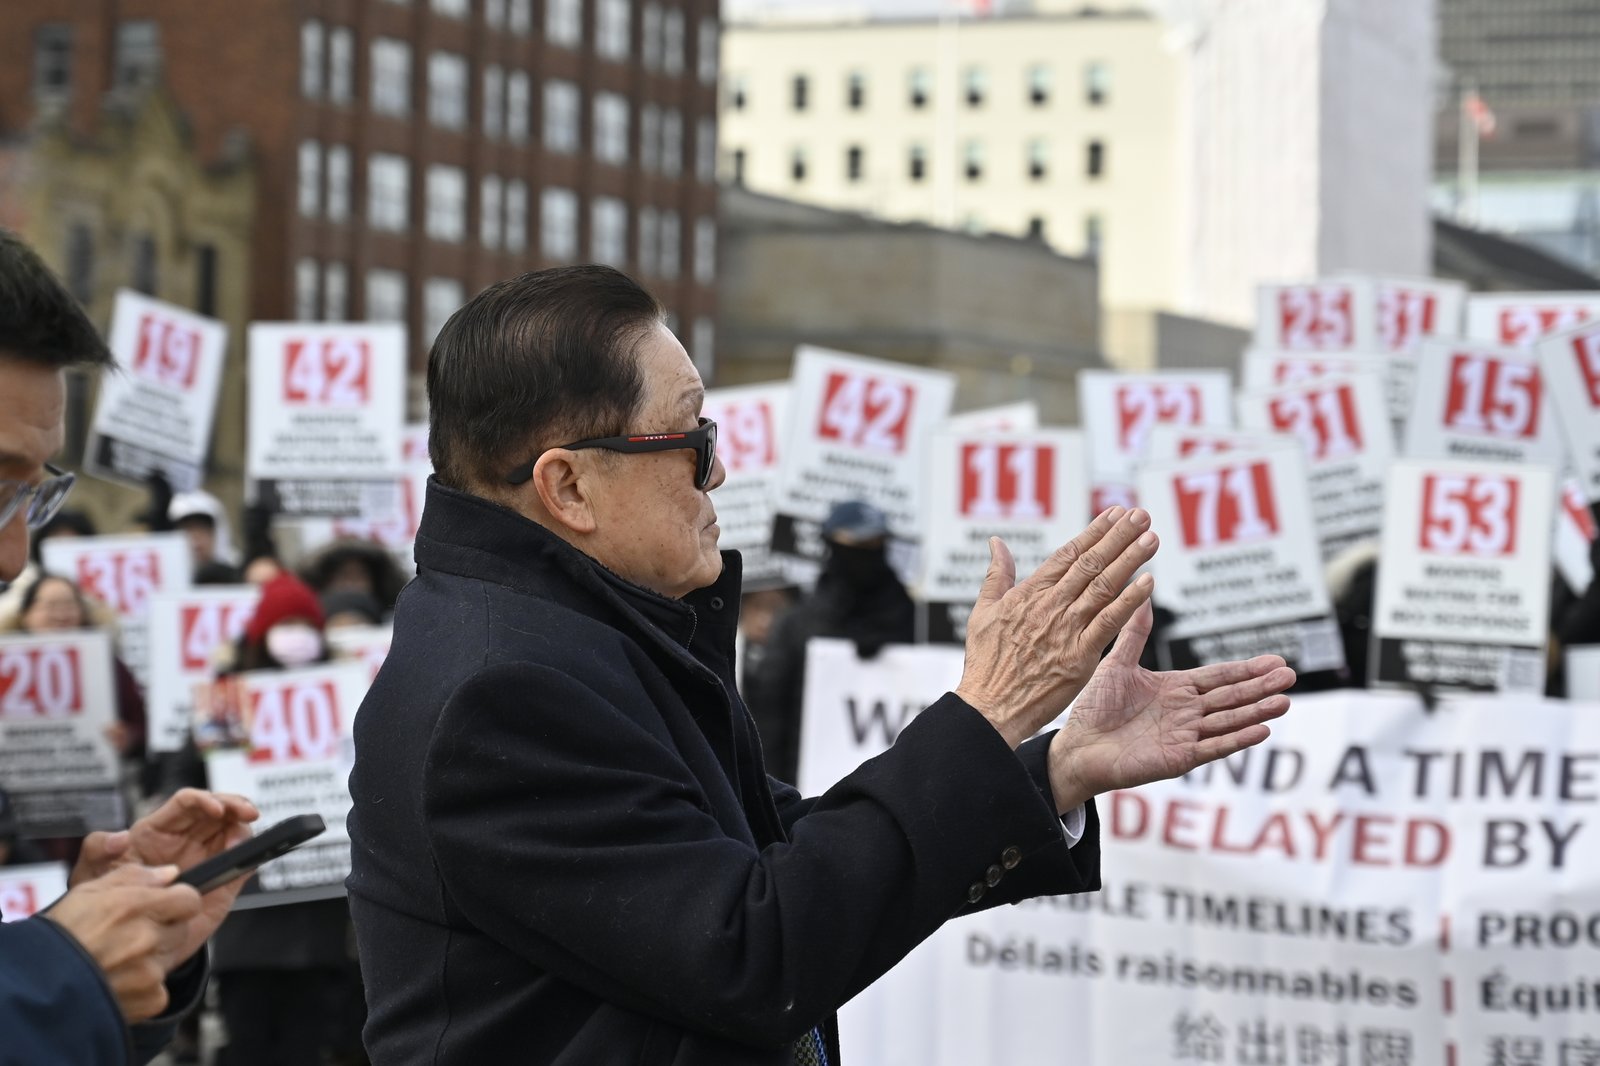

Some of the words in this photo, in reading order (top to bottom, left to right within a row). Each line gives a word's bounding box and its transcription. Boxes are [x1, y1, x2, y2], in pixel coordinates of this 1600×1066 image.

[284, 340, 371, 405] 42
[1445, 352, 1543, 439] 15
[817, 371, 915, 455] 42
[960, 443, 1055, 518] 11
[1173, 458, 1280, 550] 71
[1420, 473, 1520, 555] 53
[0, 648, 81, 713] 20
[247, 680, 341, 764] 40
[1328, 743, 1377, 797] A
[1404, 748, 1600, 802] TIME
[1111, 790, 1453, 868] DELAYED
[1483, 818, 1584, 869] BY
[1161, 884, 1413, 946] TIMELINES
[966, 932, 1103, 976] Délais
[1116, 950, 1418, 1012] raisonnables
